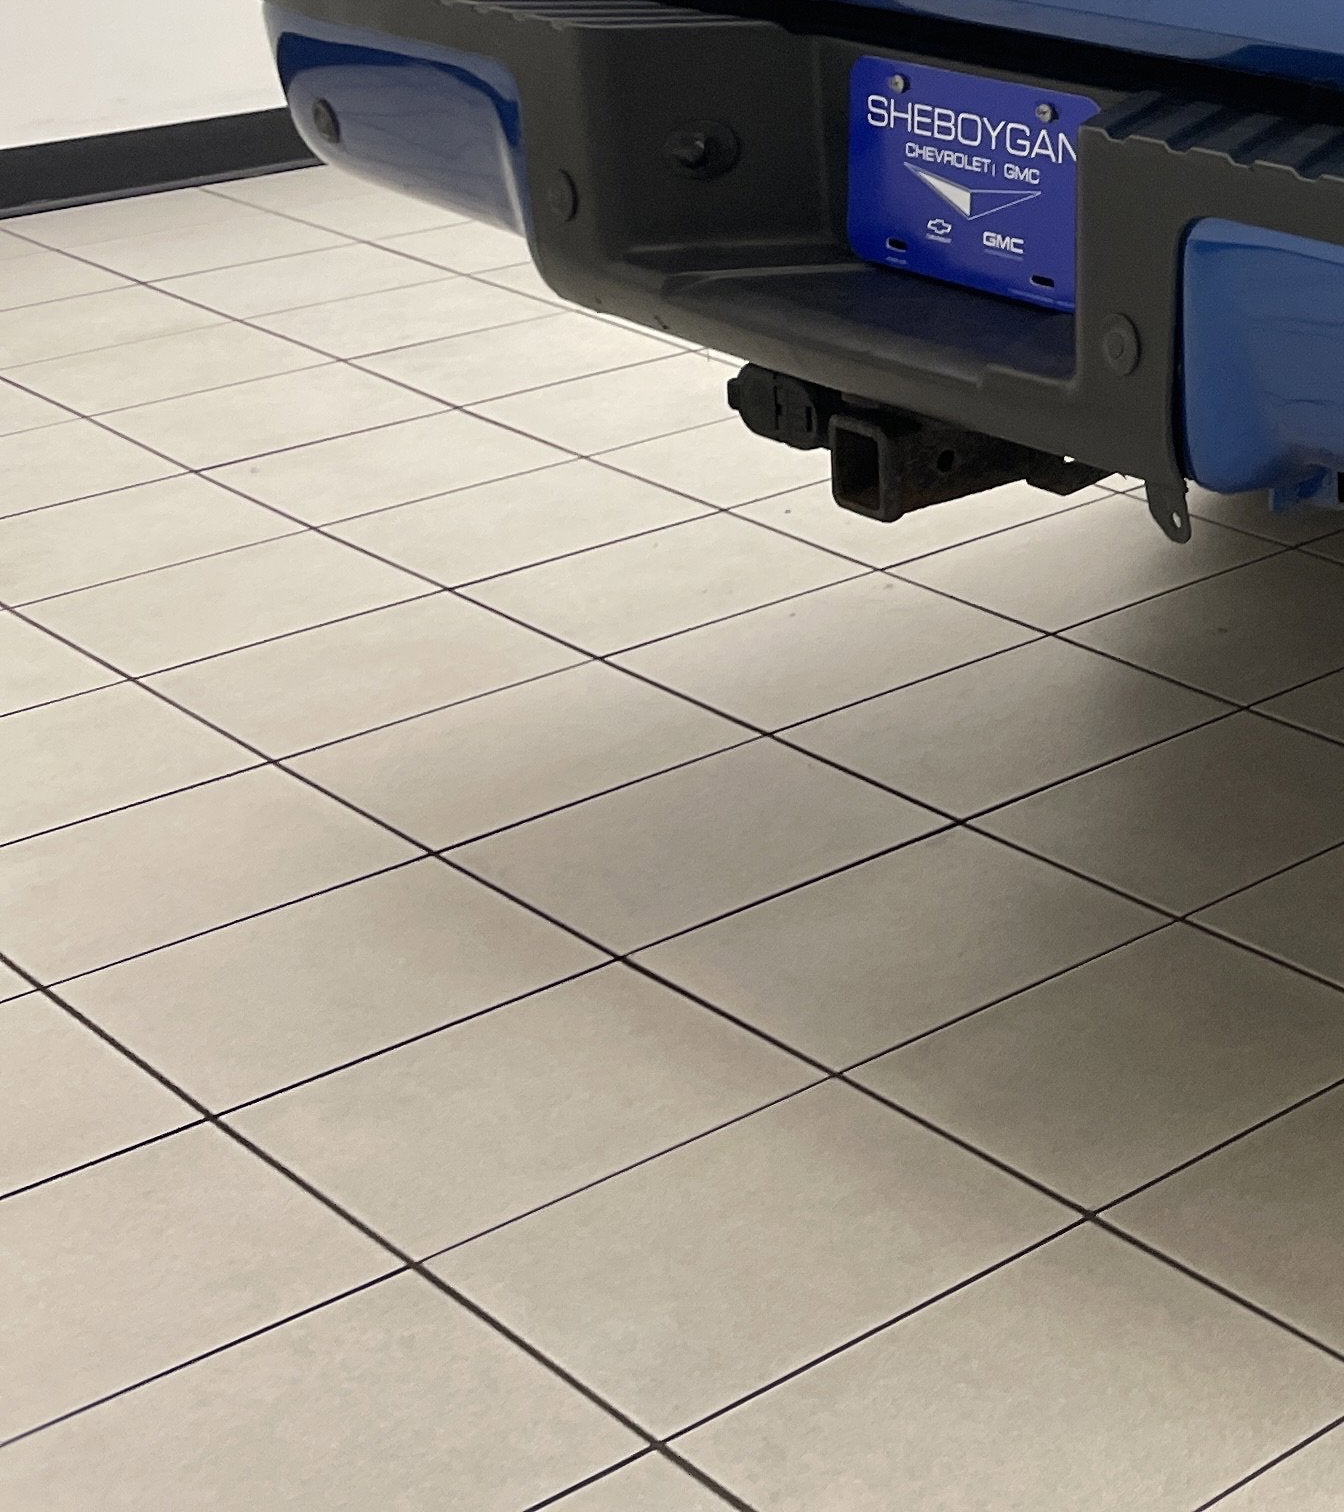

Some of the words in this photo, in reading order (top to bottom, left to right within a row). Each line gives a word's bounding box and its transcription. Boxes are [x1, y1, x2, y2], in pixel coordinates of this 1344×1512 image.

[867, 94, 1077, 164] SHEBOYGAN
[905, 142, 991, 173] CHEVROLET
[1004, 164, 1040, 185] GMC
[982, 231, 1025, 255] GMC
